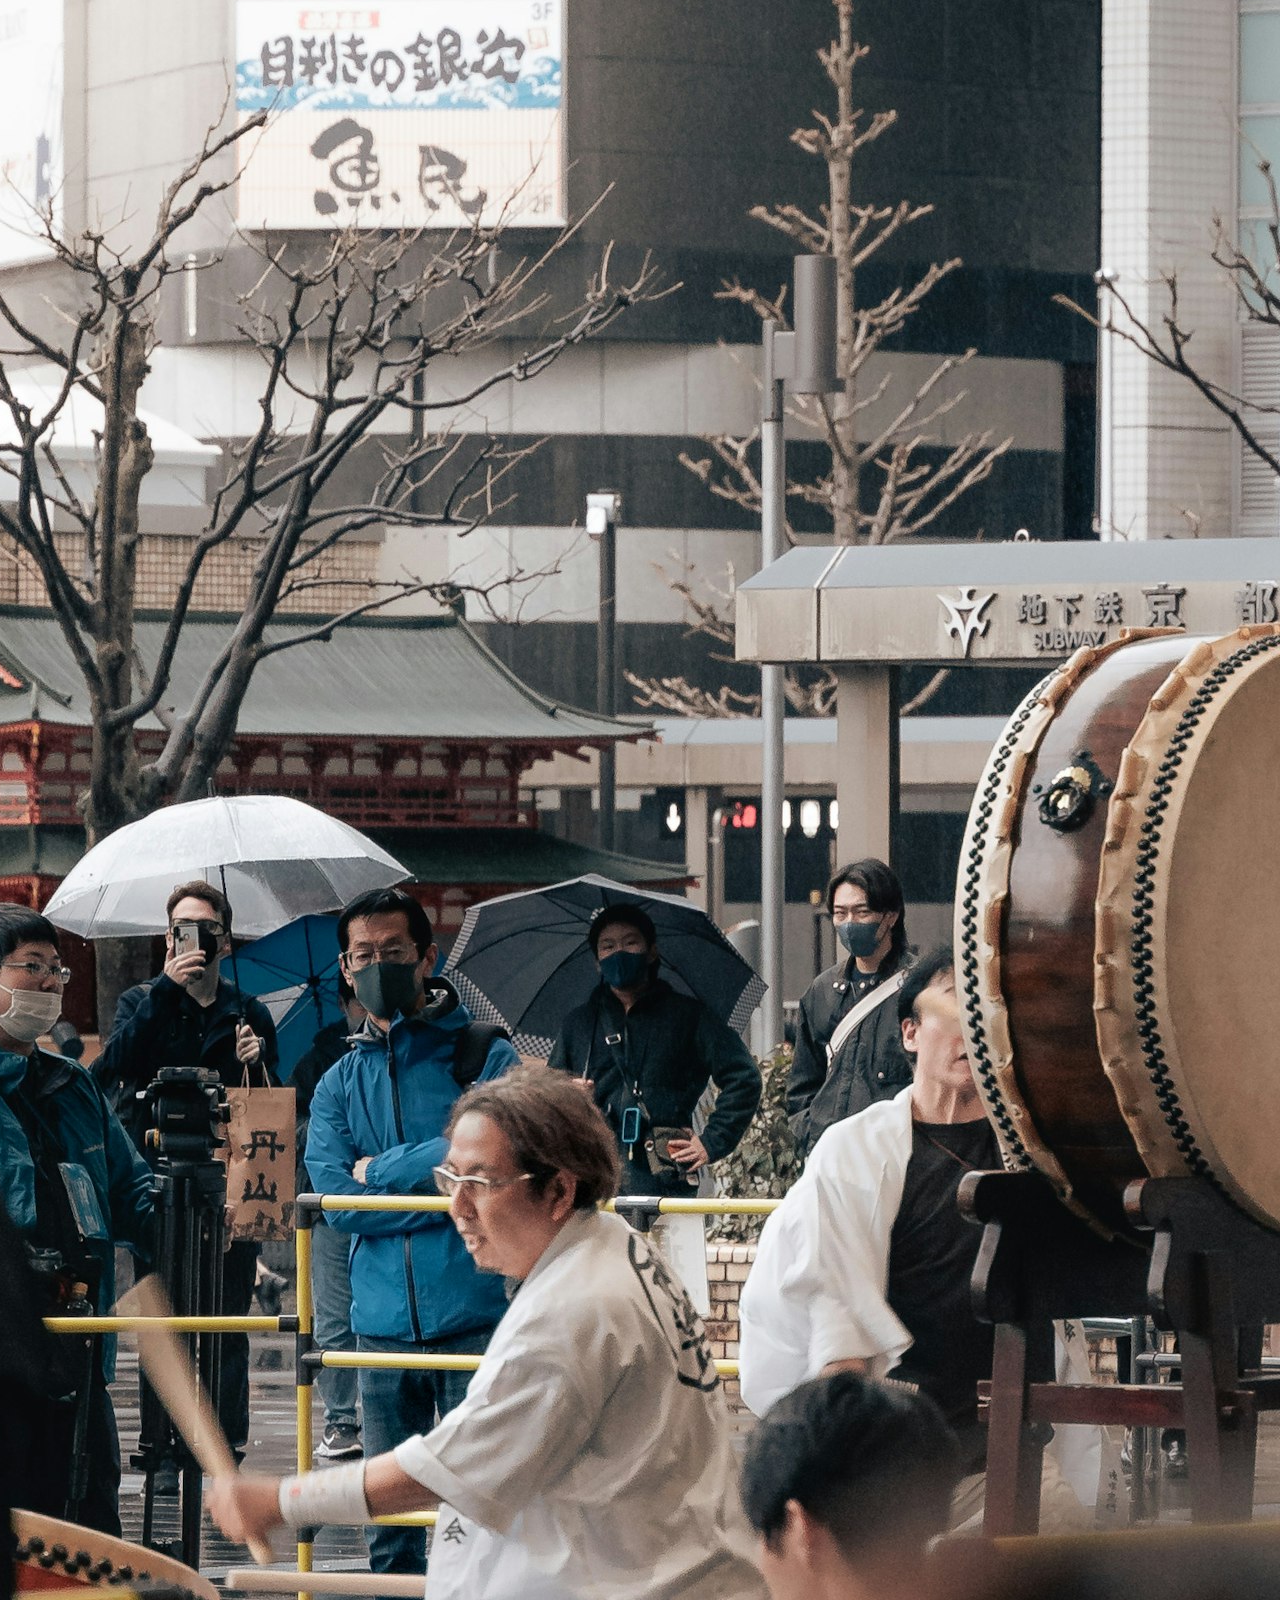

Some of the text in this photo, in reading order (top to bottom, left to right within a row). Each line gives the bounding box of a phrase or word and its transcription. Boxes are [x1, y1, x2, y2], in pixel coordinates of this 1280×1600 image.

[531, 2, 554, 21] 3F
[260, 26, 526, 93] 目利きの銀次
[310, 118, 487, 215] 魚民
[1017, 592, 1123, 625] 地下鉄
[1033, 629, 1107, 651] SUBWAY
[241, 1130, 287, 1204] 丹山
[442, 1517, 467, 1545] 会
